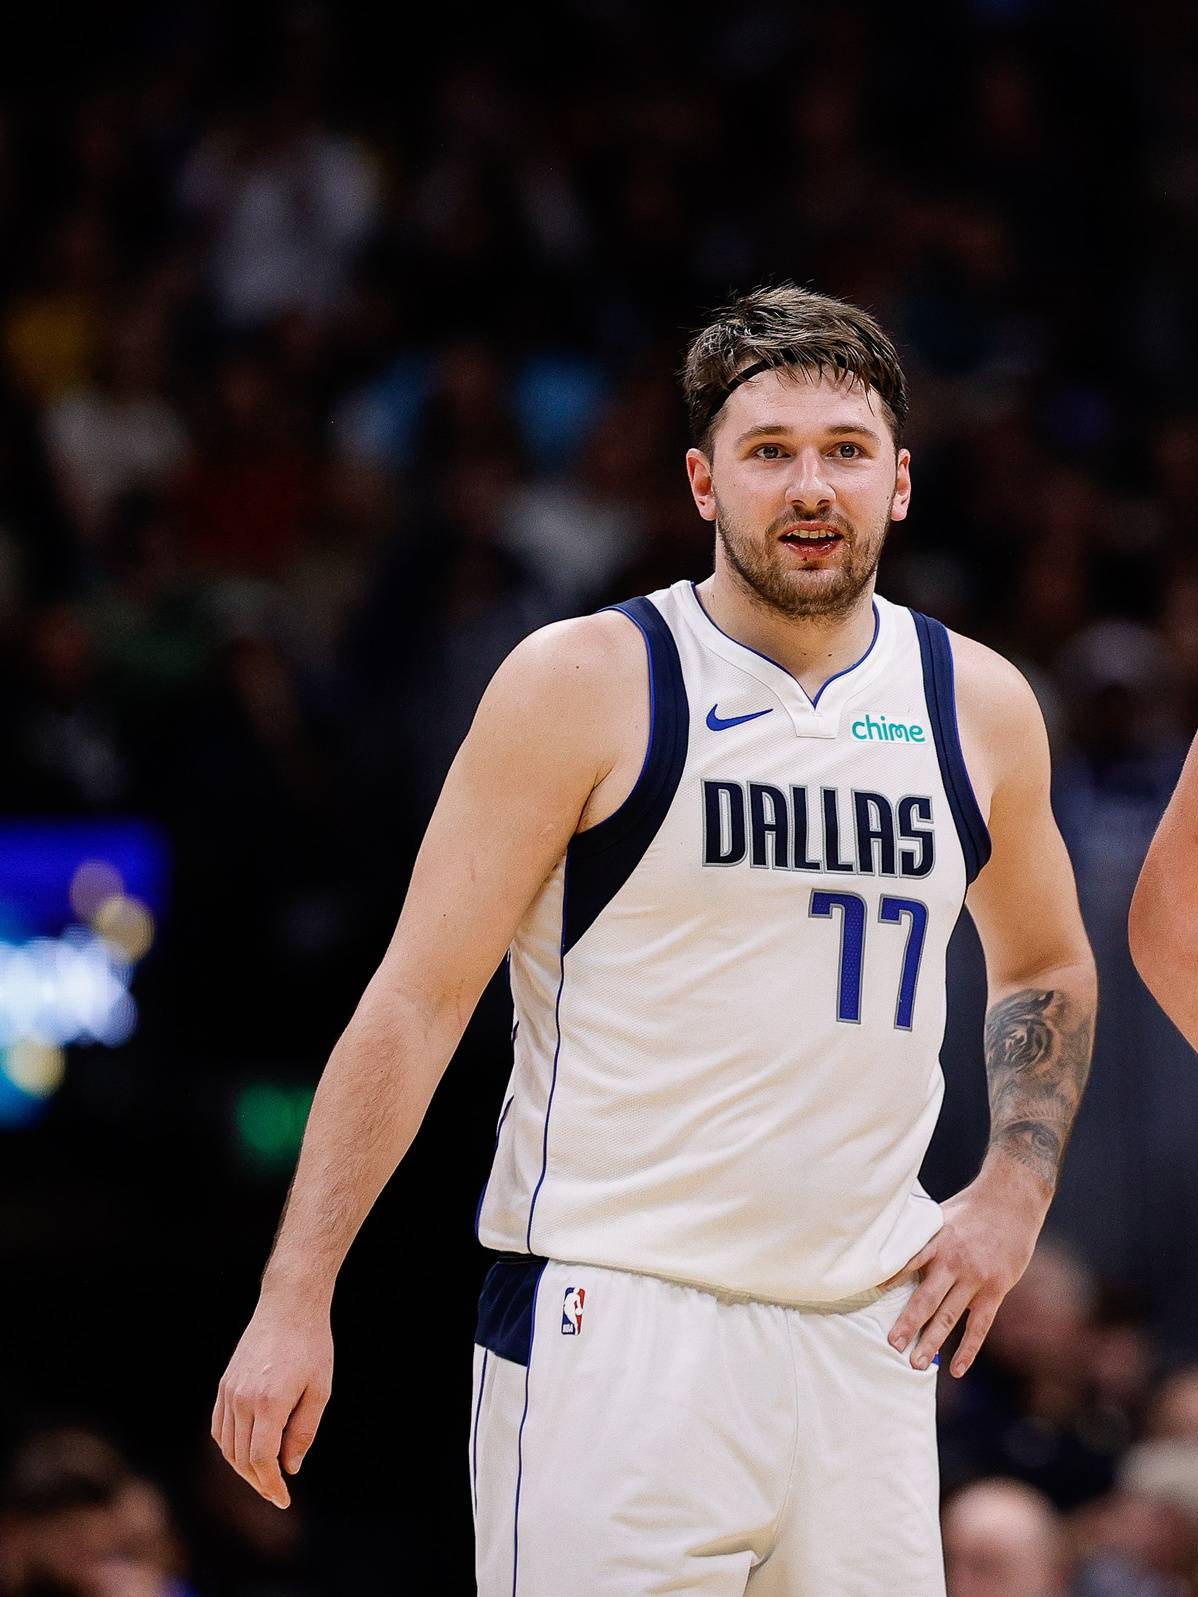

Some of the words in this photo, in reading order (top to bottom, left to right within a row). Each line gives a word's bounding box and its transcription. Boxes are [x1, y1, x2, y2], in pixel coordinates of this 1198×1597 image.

[852, 714, 926, 743] chime
[701, 778, 935, 879] DALLAS
[808, 888, 929, 1032] 77
